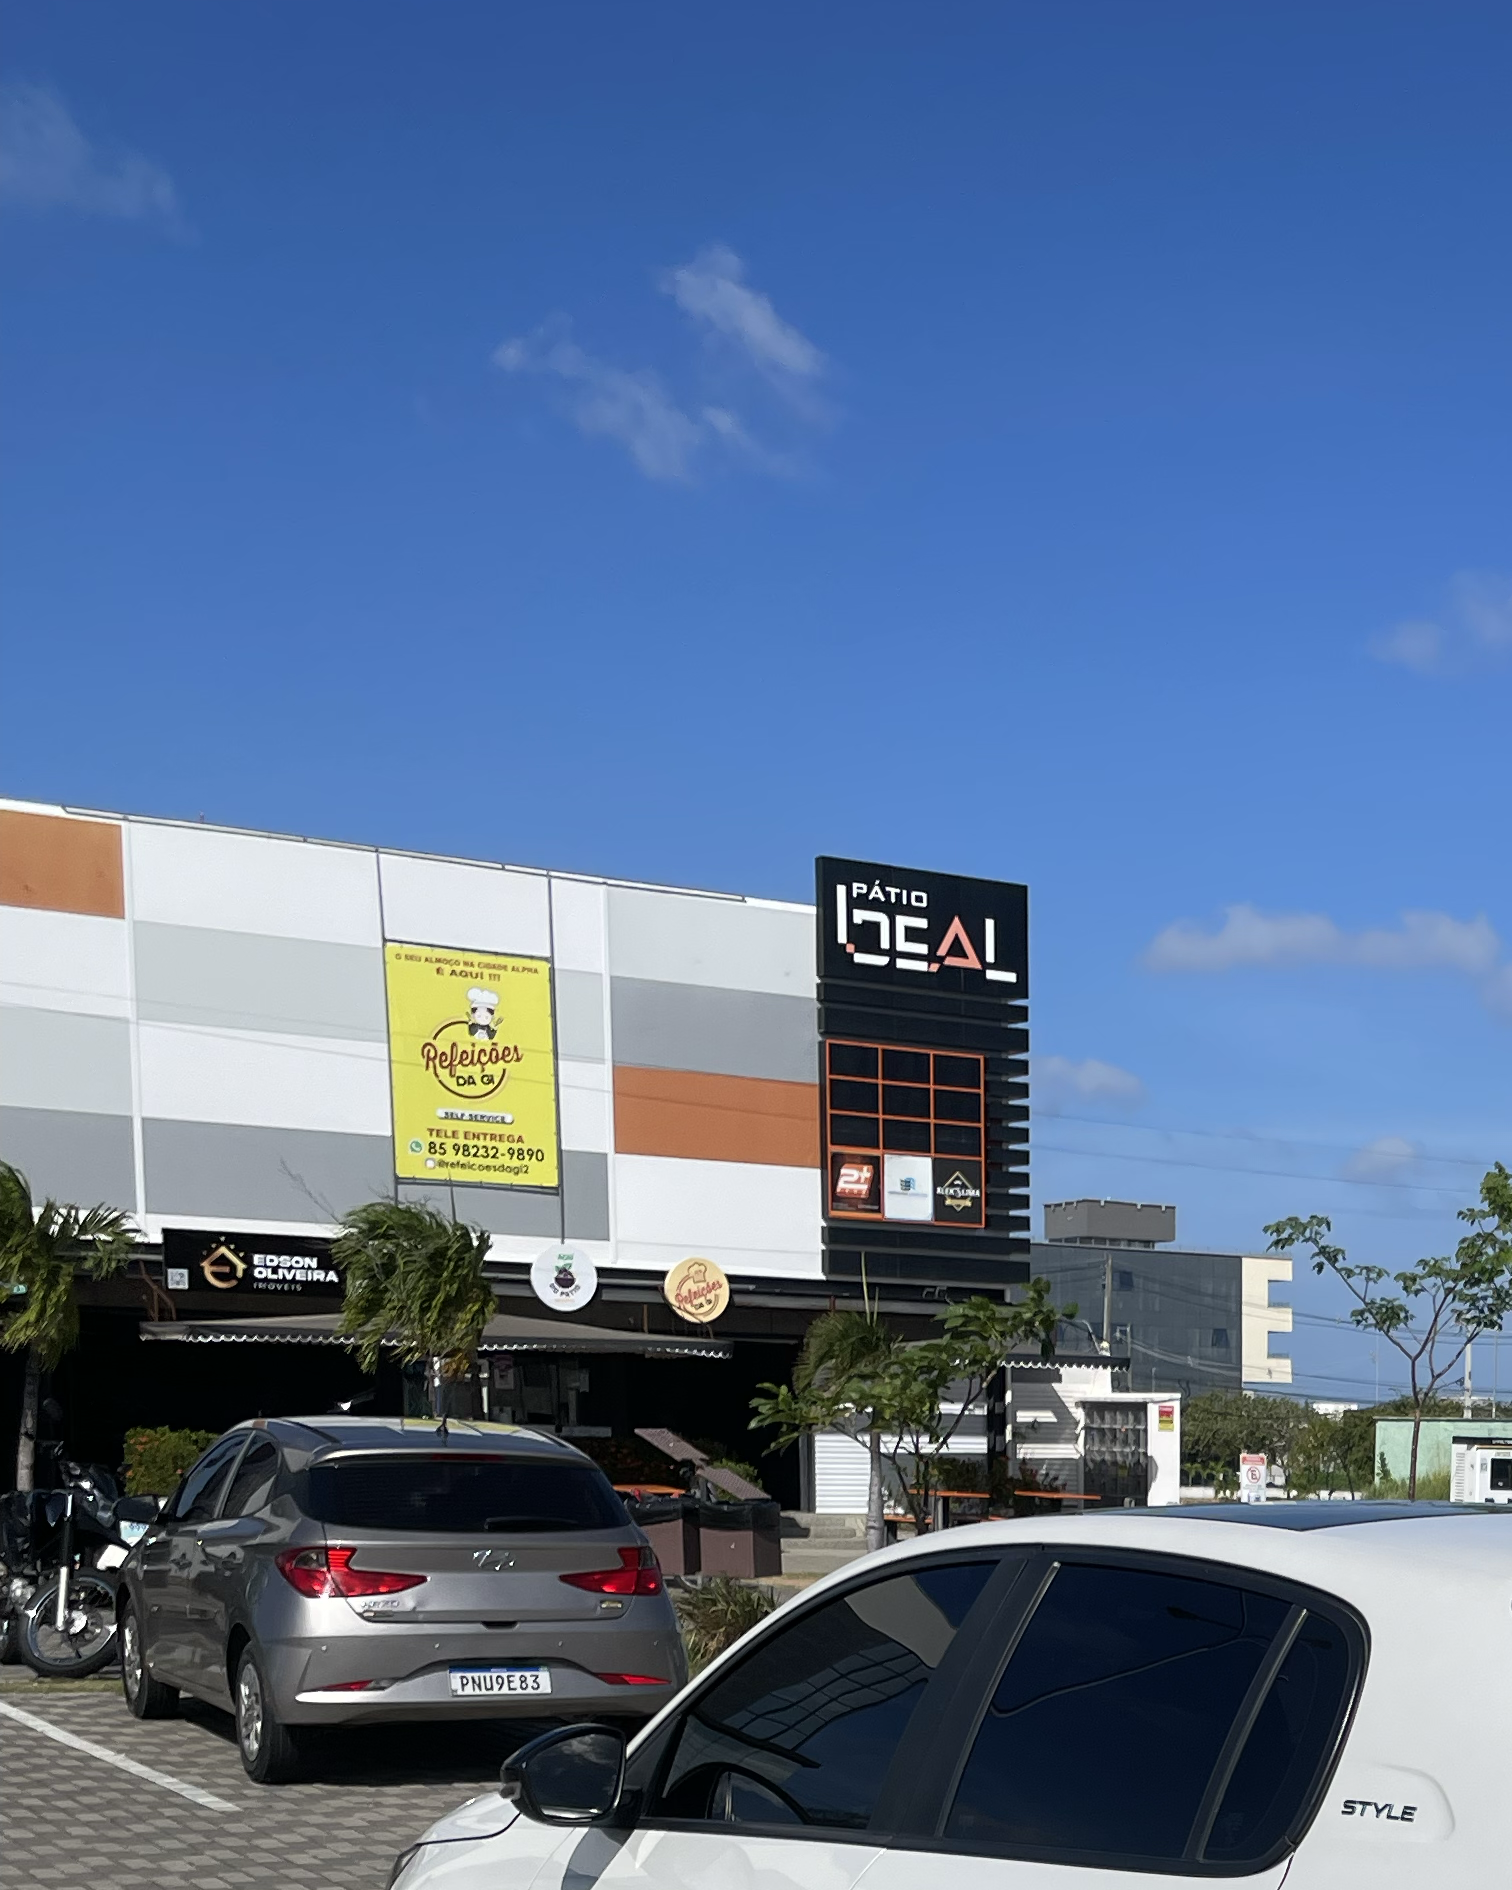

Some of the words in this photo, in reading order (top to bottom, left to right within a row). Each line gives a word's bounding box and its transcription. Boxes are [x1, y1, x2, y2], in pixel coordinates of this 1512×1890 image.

[852, 879, 928, 908] PÁTIO
[836, 883, 1017, 983] IDEAL
[421, 1042, 524, 1078] Refeições
[456, 1075, 477, 1087] DA
[427, 1128, 460, 1139] TELE
[463, 1131, 525, 1144] ENTREGA
[428, 1141, 447, 1156] 85
[452, 1143, 545, 1163] 98232-9890
[253, 1254, 318, 1269] EDSON
[253, 1268, 339, 1283] OLIVEIRA
[459, 1674, 540, 1692] PNU9E83
[1341, 1799, 1417, 1823] STYLE
